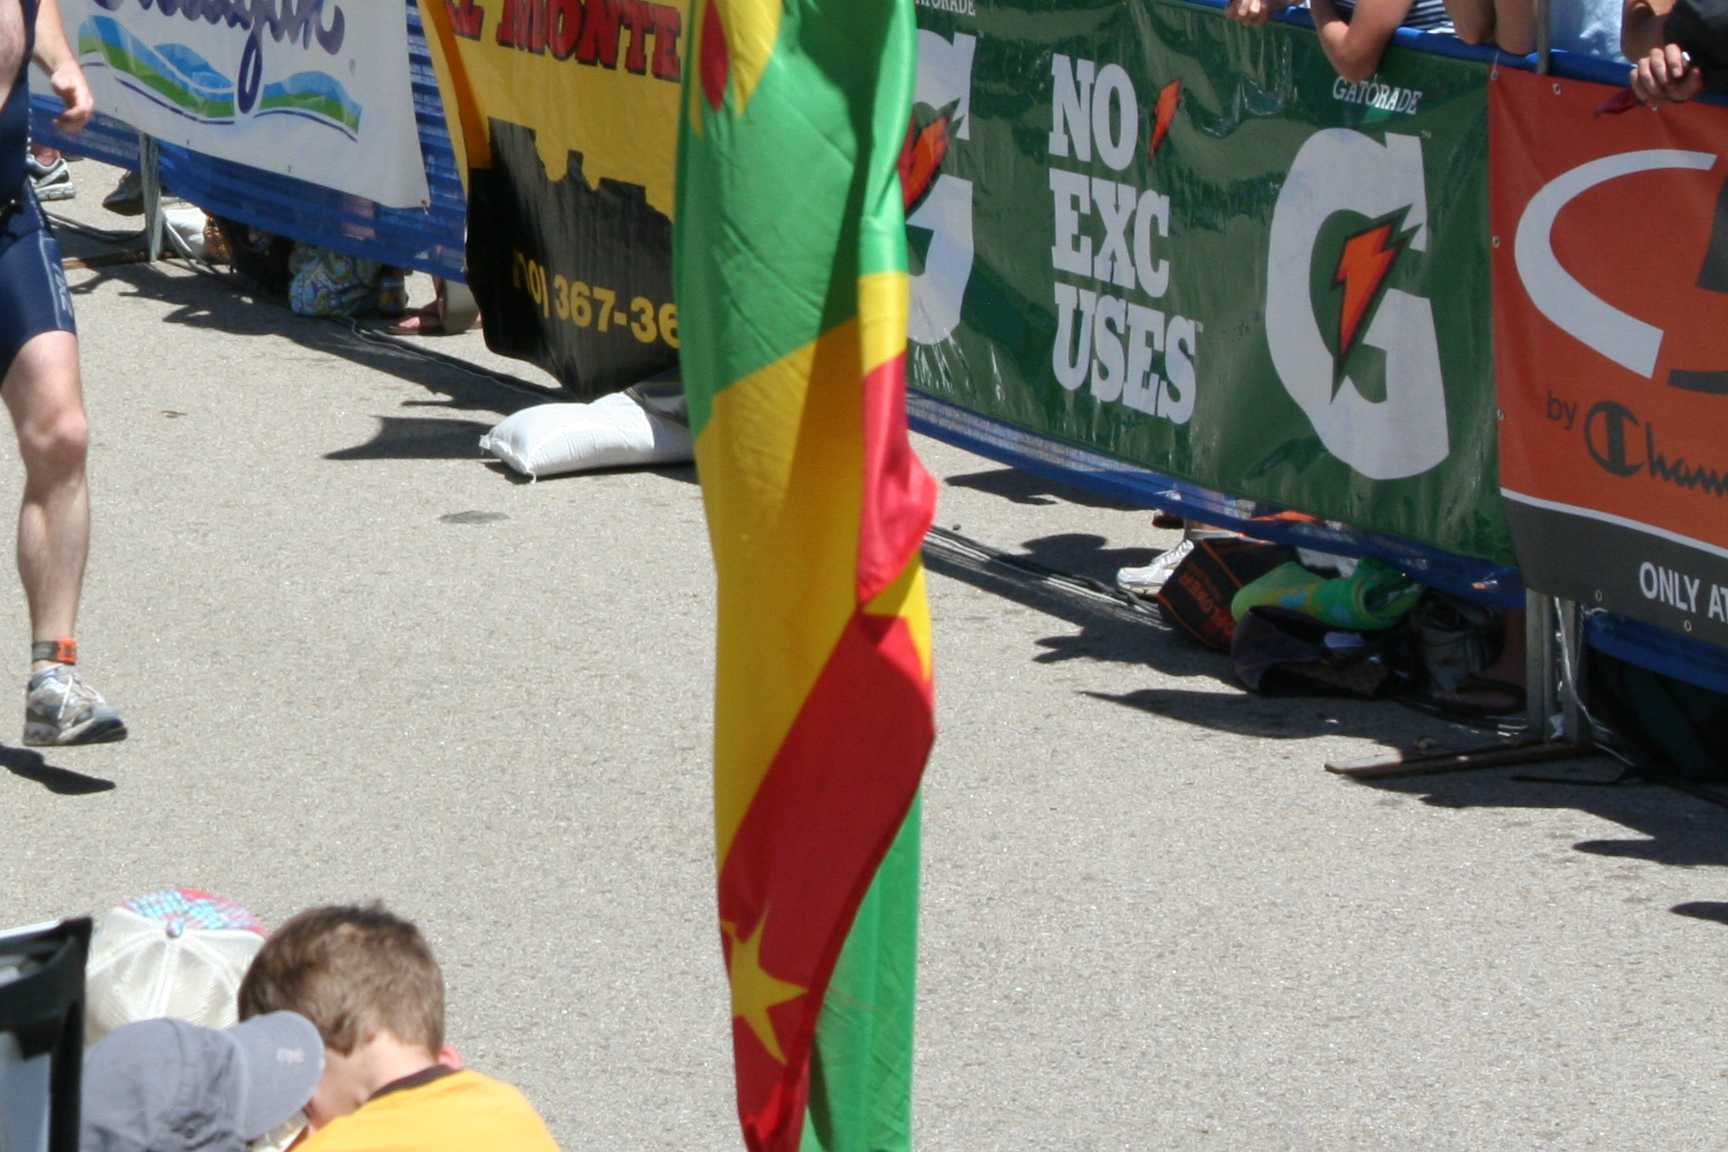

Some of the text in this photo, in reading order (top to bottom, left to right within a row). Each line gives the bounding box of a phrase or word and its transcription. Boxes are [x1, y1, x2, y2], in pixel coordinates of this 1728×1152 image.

[1048, 53, 1139, 172] NO
[1332, 74, 1424, 116] GATORADE
[1048, 166, 1171, 299] EXC
[553, 273, 681, 349] 367-36
[1265, 127, 1450, 481] G
[1052, 281, 1199, 426] USES
[1547, 389, 1578, 431] by
[1638, 561, 1702, 615] ONLY
